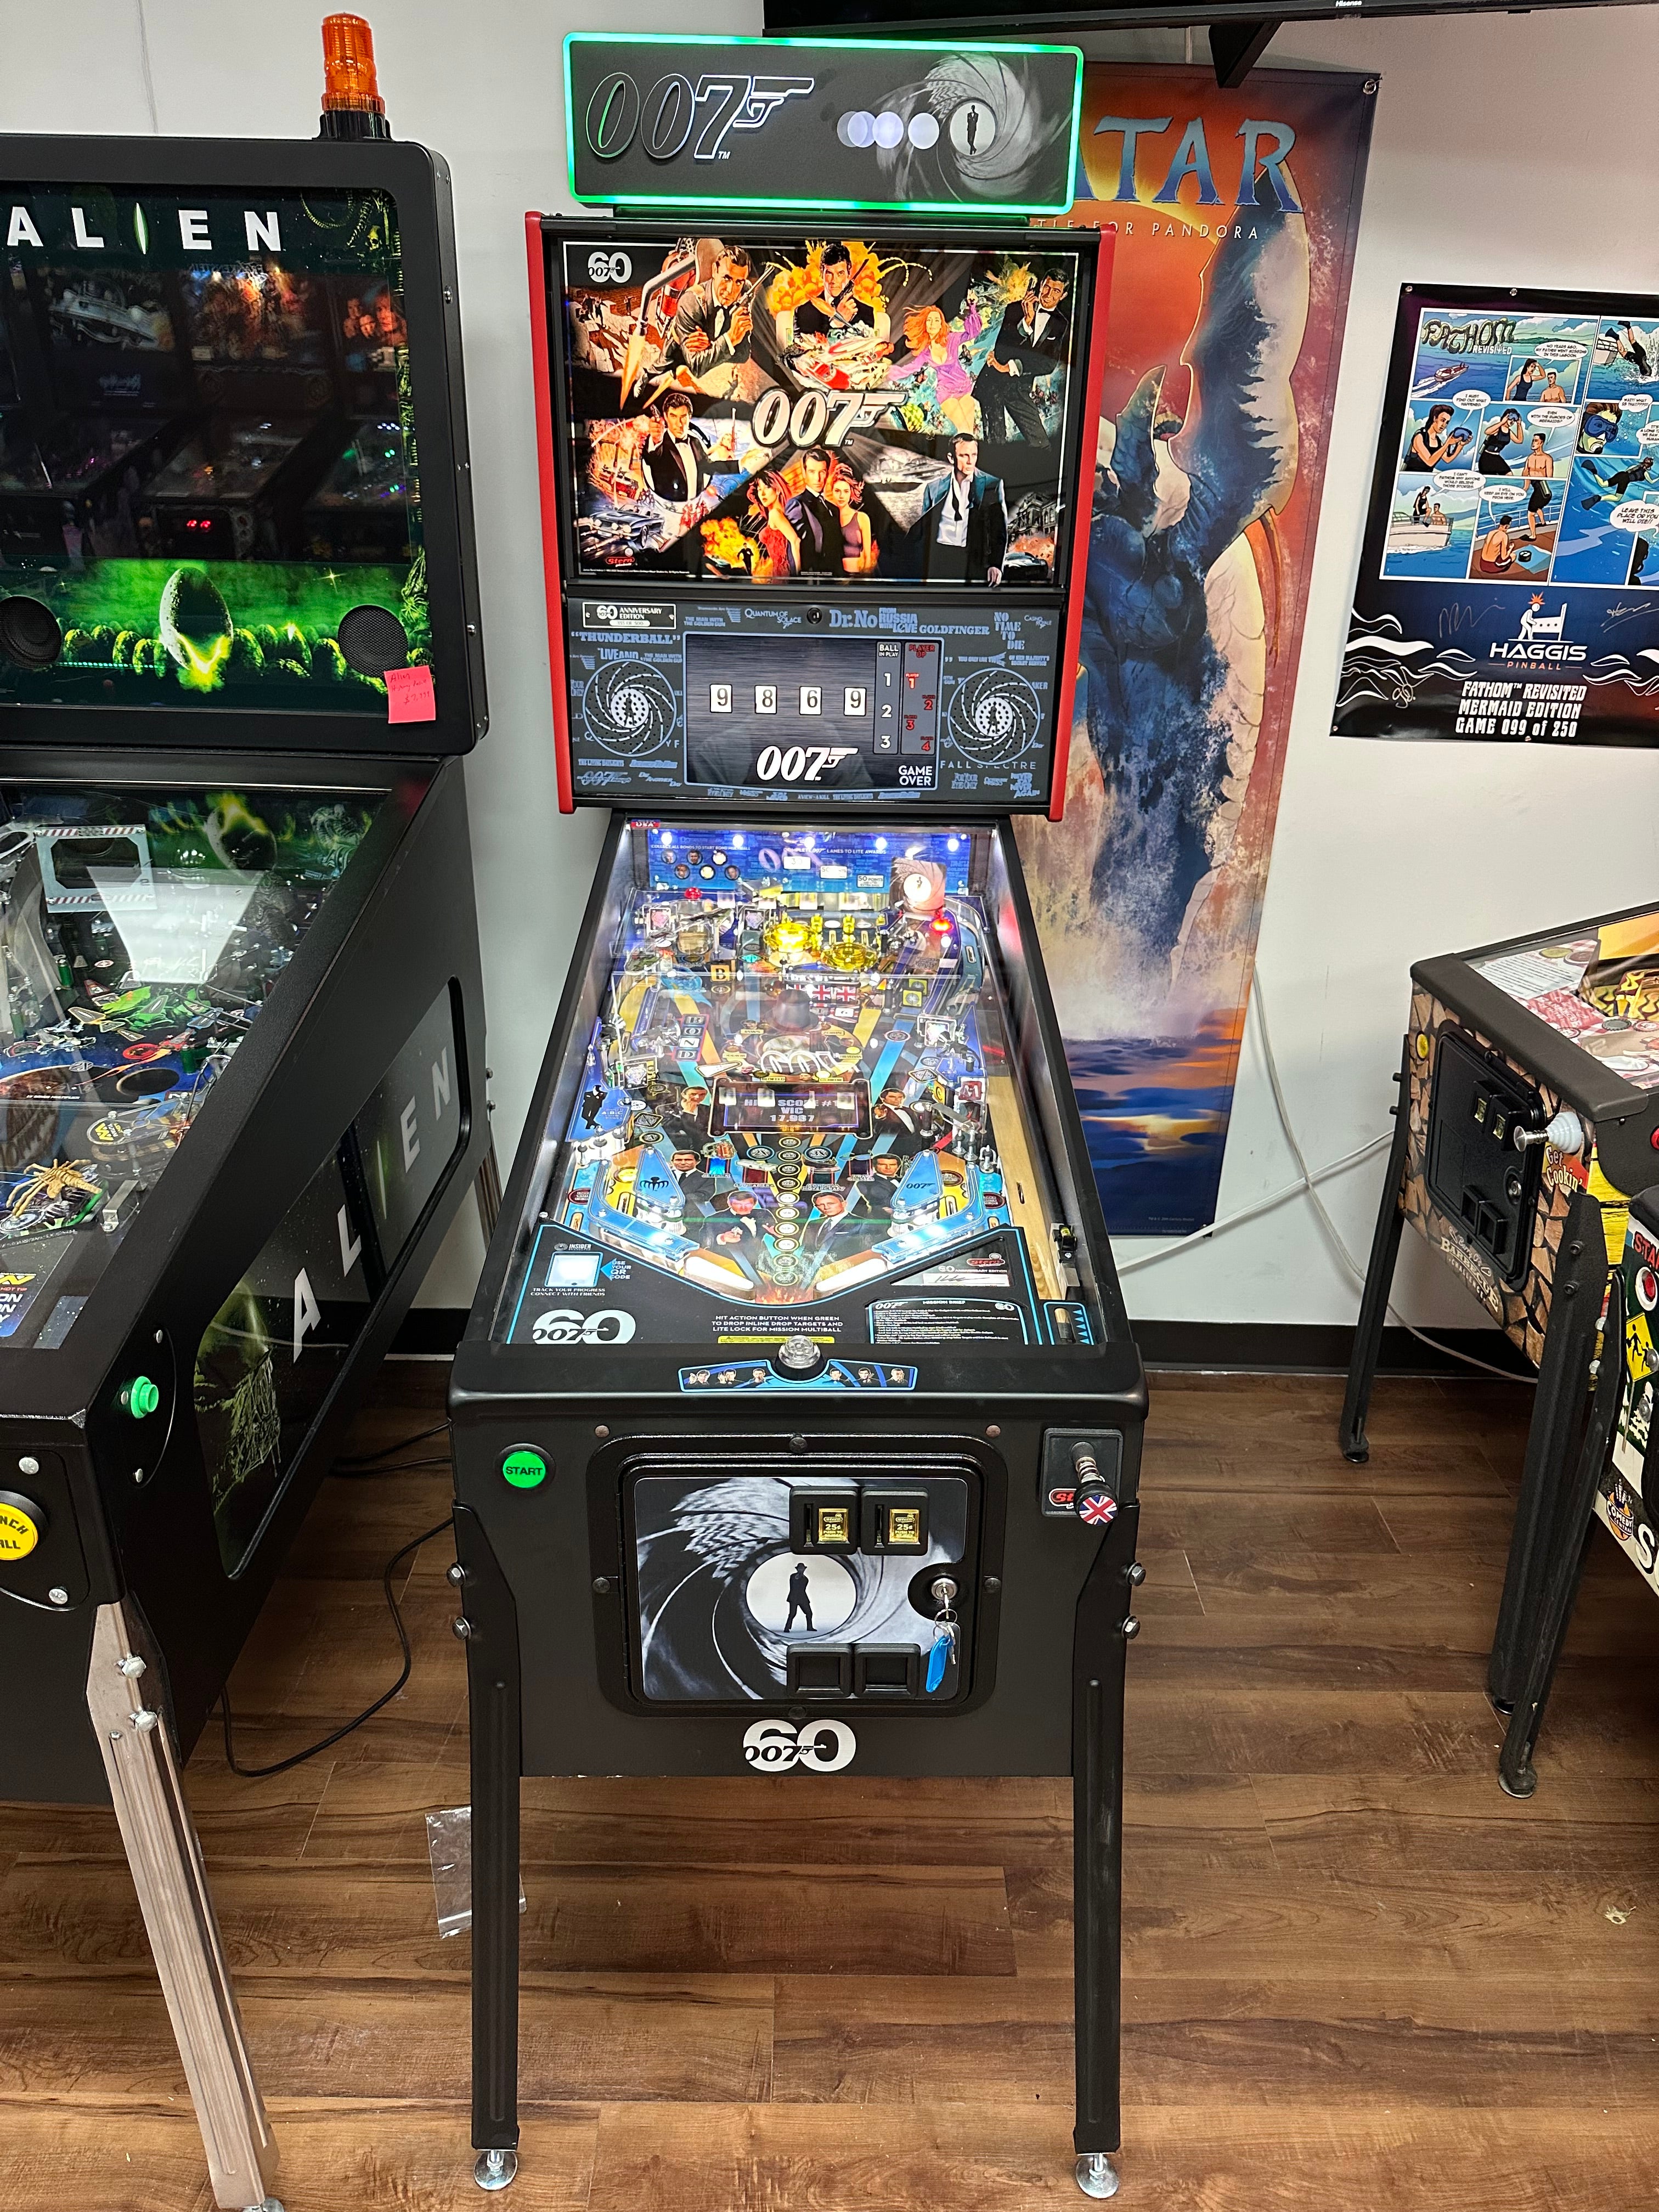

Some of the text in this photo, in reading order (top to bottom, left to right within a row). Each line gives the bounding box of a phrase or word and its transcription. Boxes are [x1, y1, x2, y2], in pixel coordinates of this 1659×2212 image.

[585, 71, 752, 159] 007
[1074, 115, 1304, 213] TAR
[7, 202, 282, 254] ALIEN
[1152, 223, 1257, 239] PANDORA
[588, 252, 631, 283] 60
[1472, 345, 1512, 354] REVISITED
[752, 388, 864, 447] 007
[744, 608, 778, 619] QUANTUM
[879, 613, 918, 624] RUSSIA
[994, 612, 1009, 622] NO
[893, 623, 918, 633] LOVE
[919, 625, 990, 635] GOLDFINGER
[995, 622, 1021, 631] TIME
[1001, 631, 1015, 640] TO
[1007, 640, 1025, 650] DIE
[1489, 642, 1588, 661] HAGGIS
[1507, 661, 1561, 670] PINBALL
[884, 673, 891, 686] 1
[909, 678, 915, 689] 1
[717, 688, 861, 708] 9 8 6 9
[1522, 684, 1587, 701] REVISITED
[882, 704, 891, 718] 2
[924, 699, 933, 710] 2
[1458, 699, 1582, 719] MERMAID EDITION
[906, 719, 915, 730] 3
[1455, 717, 1577, 737] GAME 099 of 250
[881, 735, 891, 748] 3
[922, 741, 930, 751] 4
[757, 746, 831, 781] 007
[899, 765, 933, 776] GAME
[900, 776, 932, 786] OVER
[1546, 1146, 1564, 1167] Get
[1441, 1237, 1499, 1312] BARBECUE
[532, 1309, 636, 1344] 60
[506, 1466, 543, 1475] START
[1607, 1500, 1632, 1528] COMEDY
[743, 1719, 856, 1771] 60
[743, 1746, 803, 1762] 007
